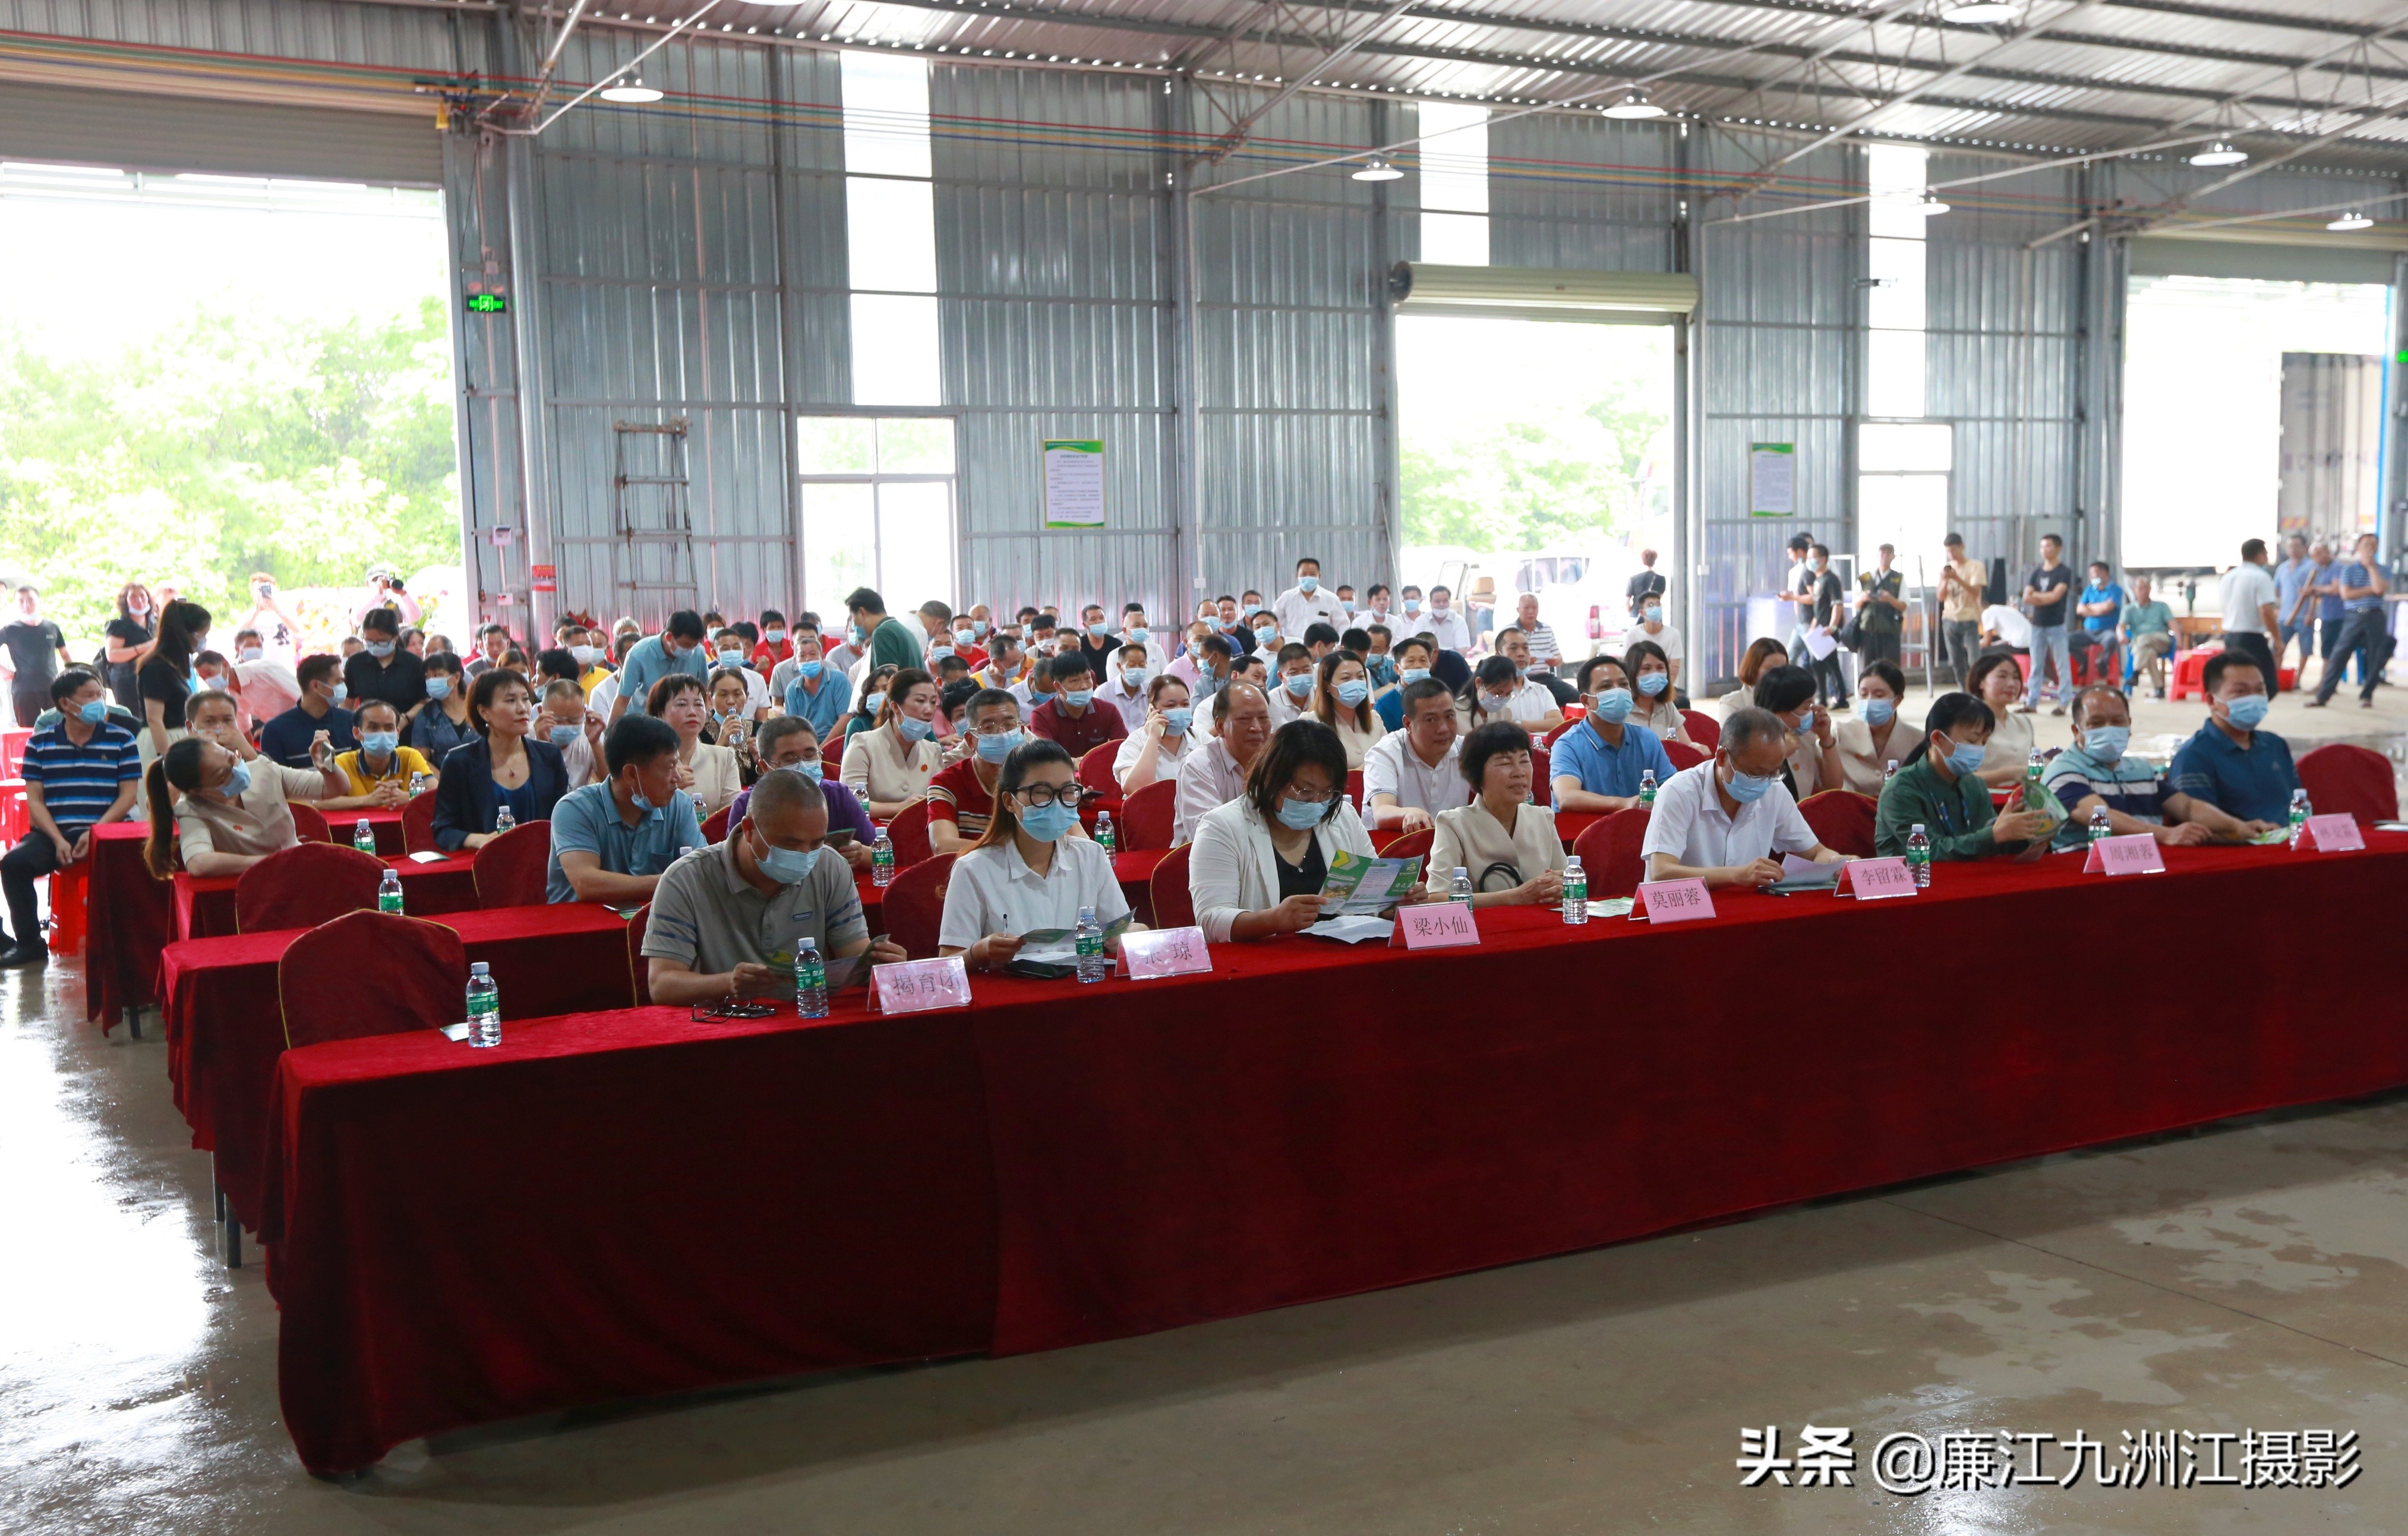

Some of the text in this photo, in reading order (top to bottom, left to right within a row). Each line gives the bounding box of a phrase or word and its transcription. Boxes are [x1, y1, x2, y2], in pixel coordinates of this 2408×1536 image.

[1650, 887, 1700, 910] 莫丽蓉
[1413, 916, 1468, 937] 梁小仙
[892, 969, 961, 996] 揭育团
